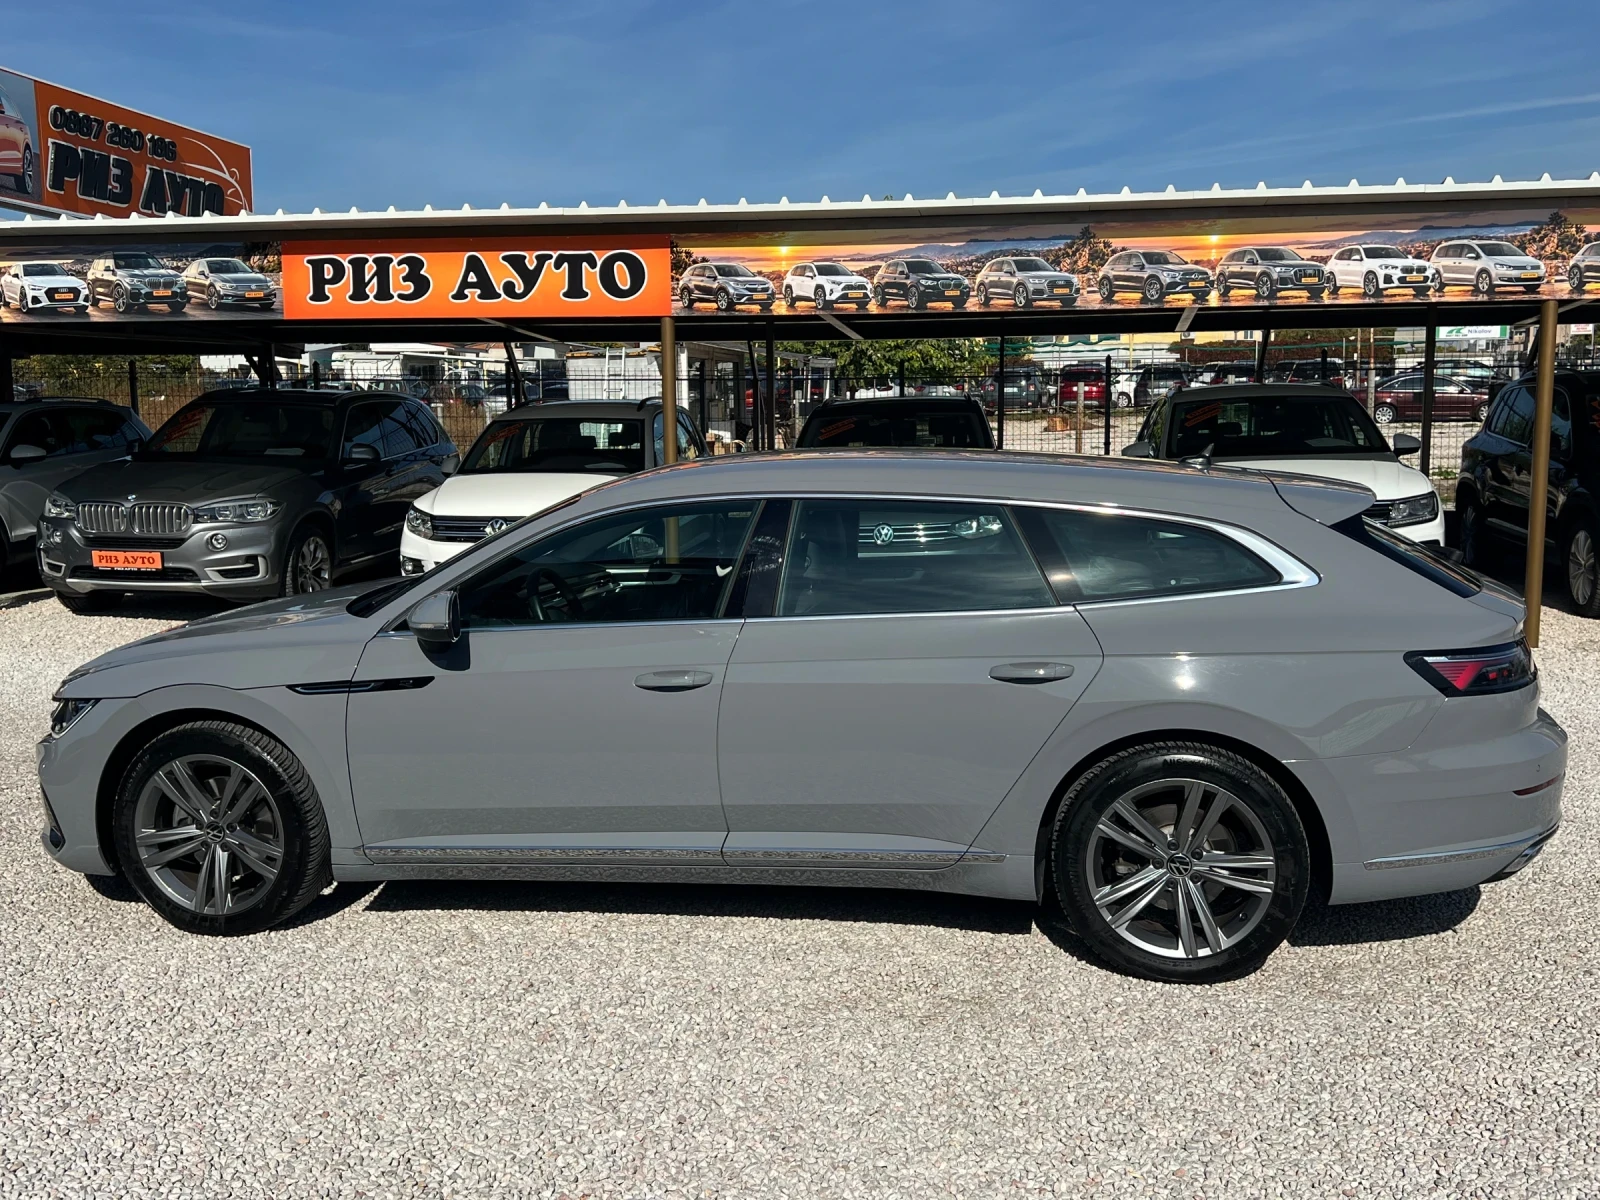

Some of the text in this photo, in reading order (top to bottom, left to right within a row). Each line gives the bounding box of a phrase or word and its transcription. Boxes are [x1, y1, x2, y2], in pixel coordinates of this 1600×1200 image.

[49, 105, 178, 163] 0887 260 186
[47, 138, 226, 217] РИЗ АУТО
[305, 249, 647, 304] РИЗ АУТО
[97, 554, 155, 565] РИЗ АУТО
